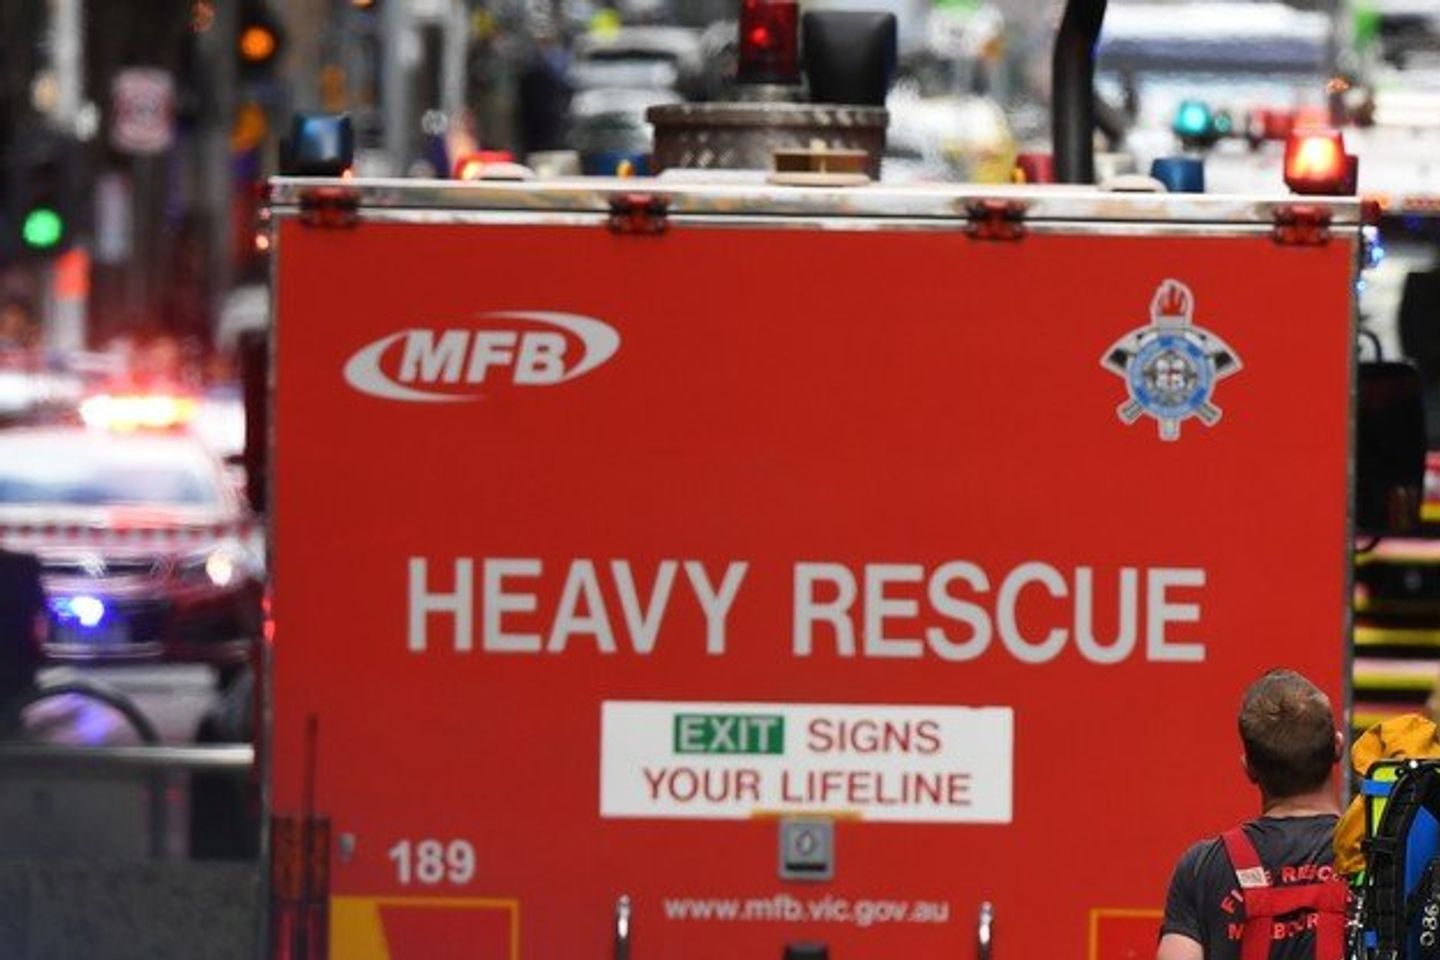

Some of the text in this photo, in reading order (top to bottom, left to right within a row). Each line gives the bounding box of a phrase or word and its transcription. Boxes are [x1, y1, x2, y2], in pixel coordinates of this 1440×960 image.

[398, 328, 567, 385] MFB
[407, 557, 1206, 664] HEAVY RESCUE
[680, 717, 941, 754] EXIT SIGNS
[644, 767, 972, 805] YOUR LIFELINE
[388, 839, 475, 884] 189
[664, 894, 949, 926] www.mfb.vic.gov.au
